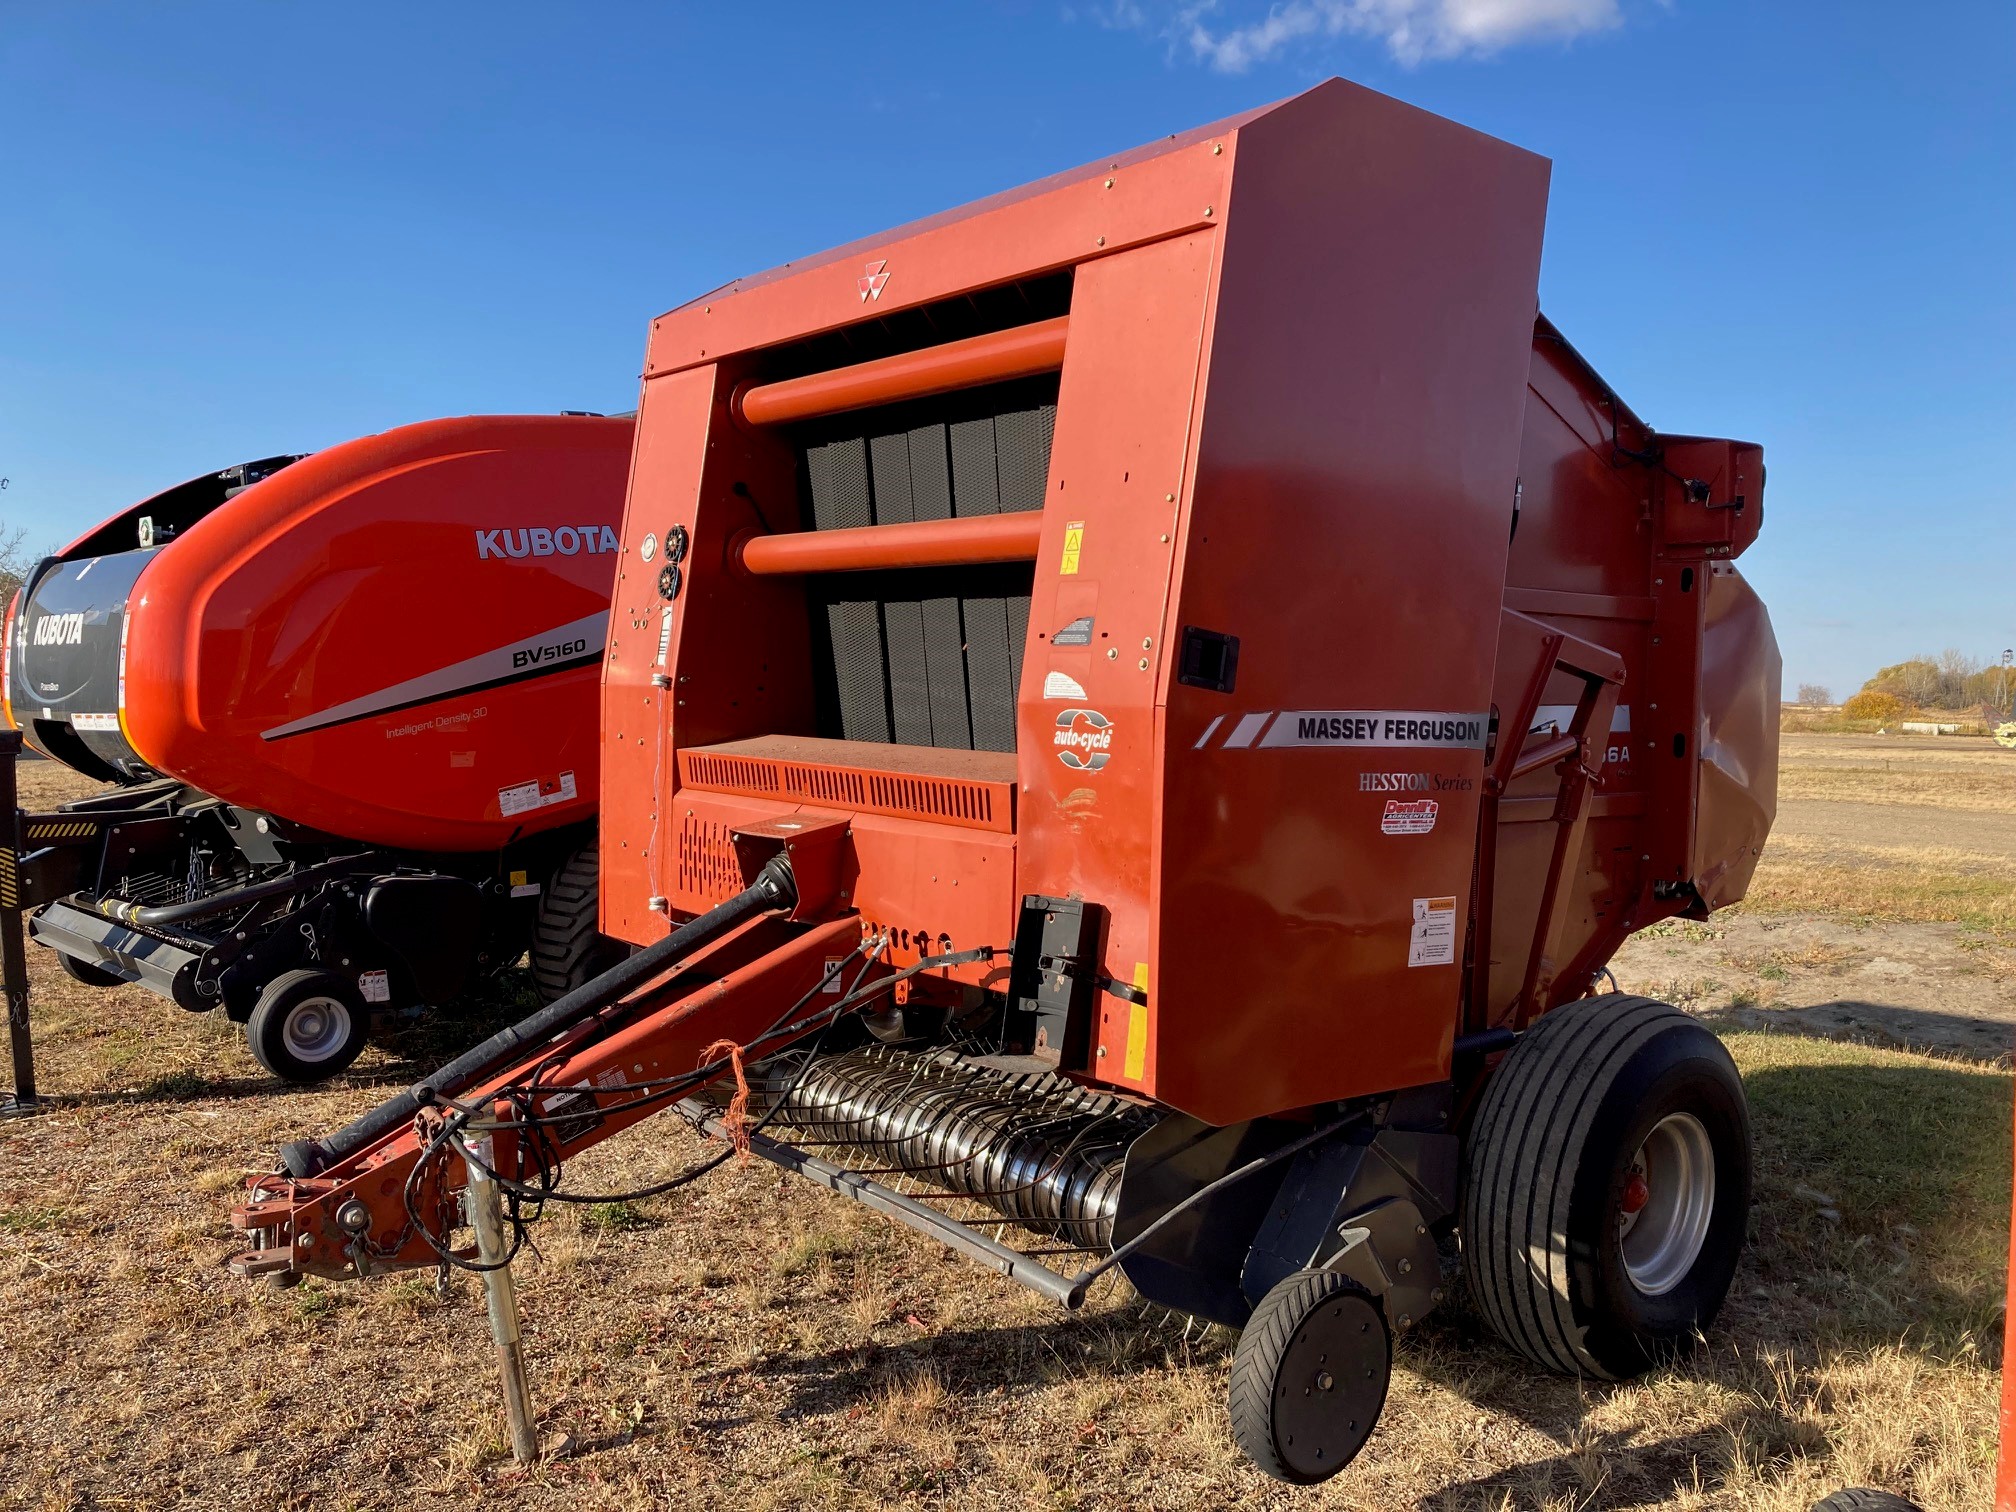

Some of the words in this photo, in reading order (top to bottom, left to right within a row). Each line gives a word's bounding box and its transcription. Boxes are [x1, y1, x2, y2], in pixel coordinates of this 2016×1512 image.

[475, 525, 620, 560] KUBOTA
[33, 613, 84, 646] KUBOTA
[512, 638, 586, 669] BV5160
[386, 720, 434, 739] Intelligent
[435, 712, 471, 727] Density
[473, 706, 488, 719] 3D
[1298, 717, 1379, 740] MASSEY
[1384, 718, 1480, 741] FERGUSON
[1602, 746, 1630, 763] 6A
[1359, 772, 1430, 791] HESSTON
[1432, 773, 1474, 791] Series
